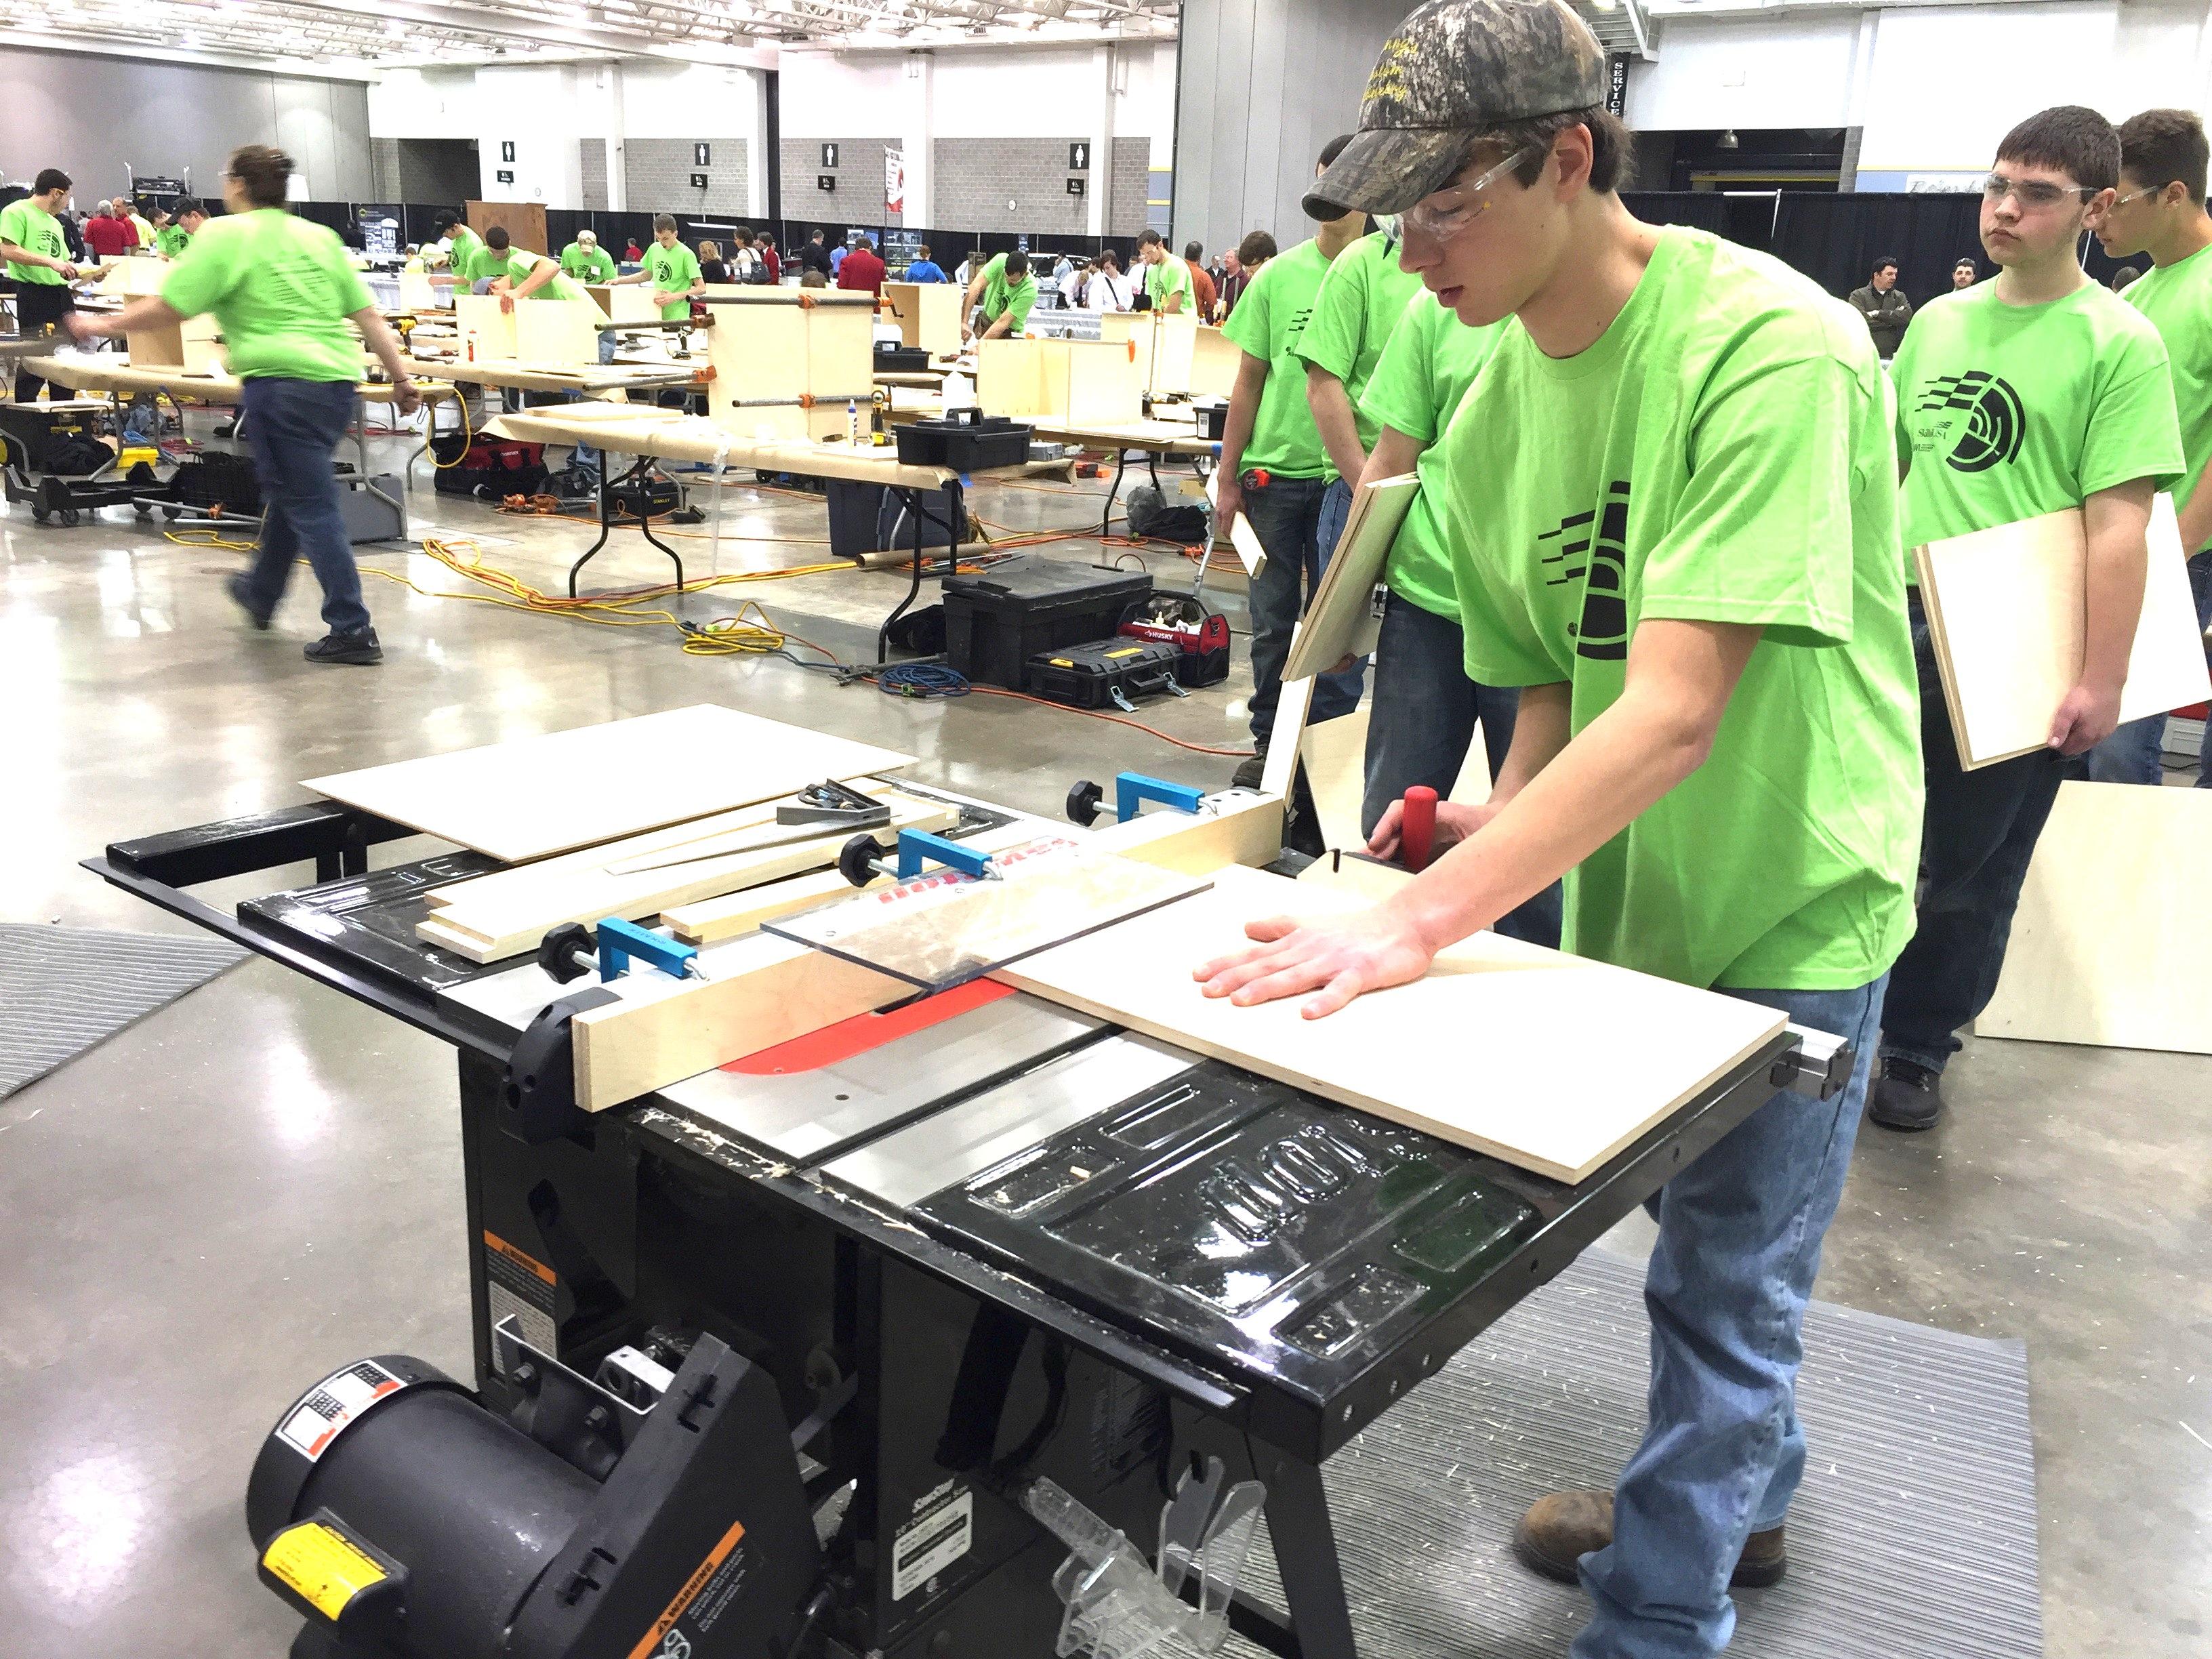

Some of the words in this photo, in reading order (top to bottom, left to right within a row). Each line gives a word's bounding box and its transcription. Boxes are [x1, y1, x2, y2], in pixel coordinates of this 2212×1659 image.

[1610, 62, 1624, 116] SERVICE
[1152, 631, 1174, 640] HUSKY
[668, 1561, 714, 1618] WARNING
